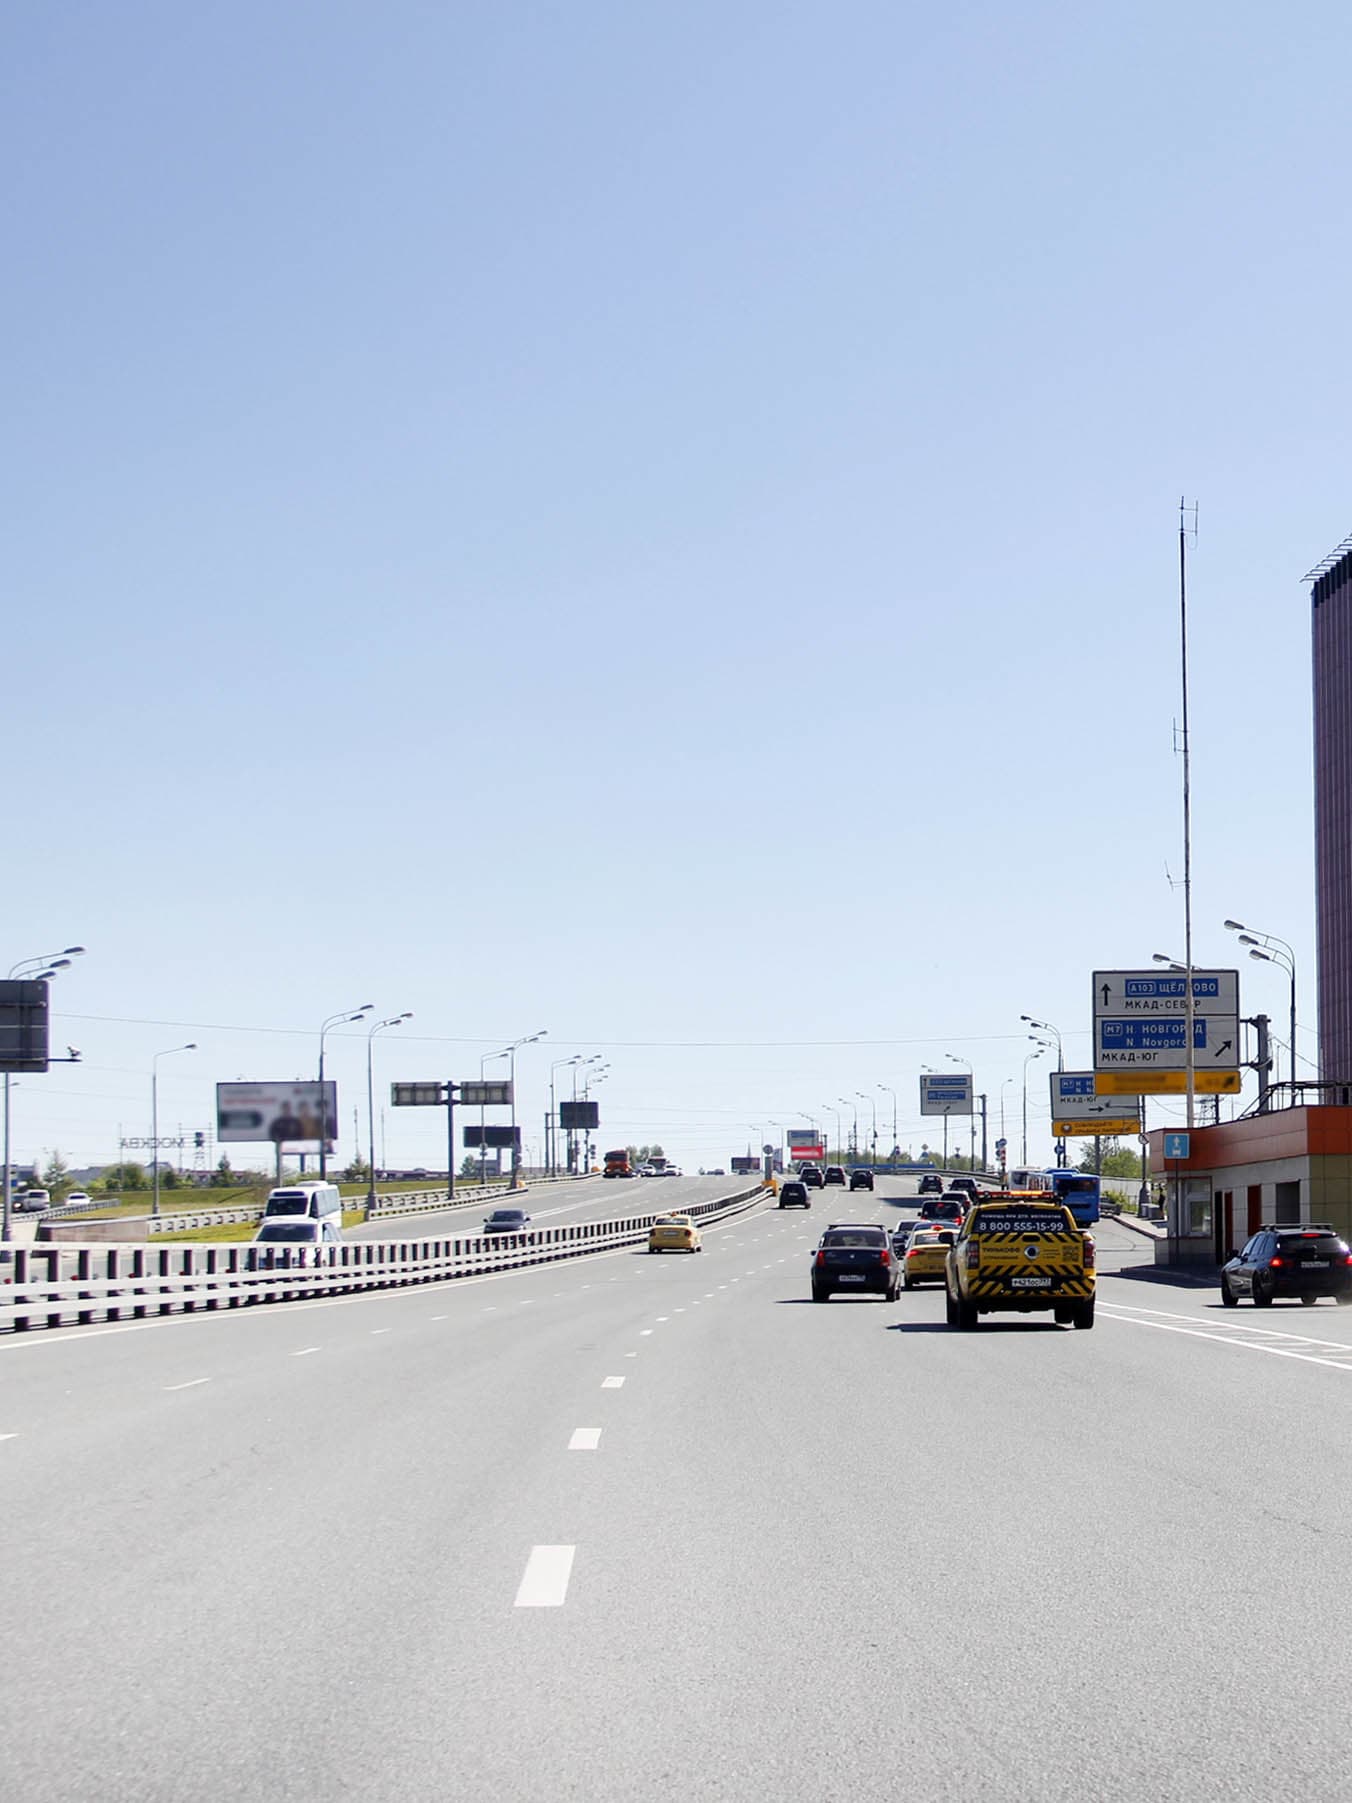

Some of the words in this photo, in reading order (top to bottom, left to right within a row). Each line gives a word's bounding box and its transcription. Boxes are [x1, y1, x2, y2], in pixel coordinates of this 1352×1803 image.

[1159, 981, 1217, 994] ЩЁЛОВО
[1124, 1000, 1201, 1011] МКАД-СЕВР
[1142, 1023, 1203, 1034] НОВГОРД
[1101, 1051, 1158, 1062] МКАД-ЮГ
[980, 1222, 987, 1231] 8
[989, 1222, 1011, 1231] 800
[1013, 1222, 1064, 1231] 555-15-99
